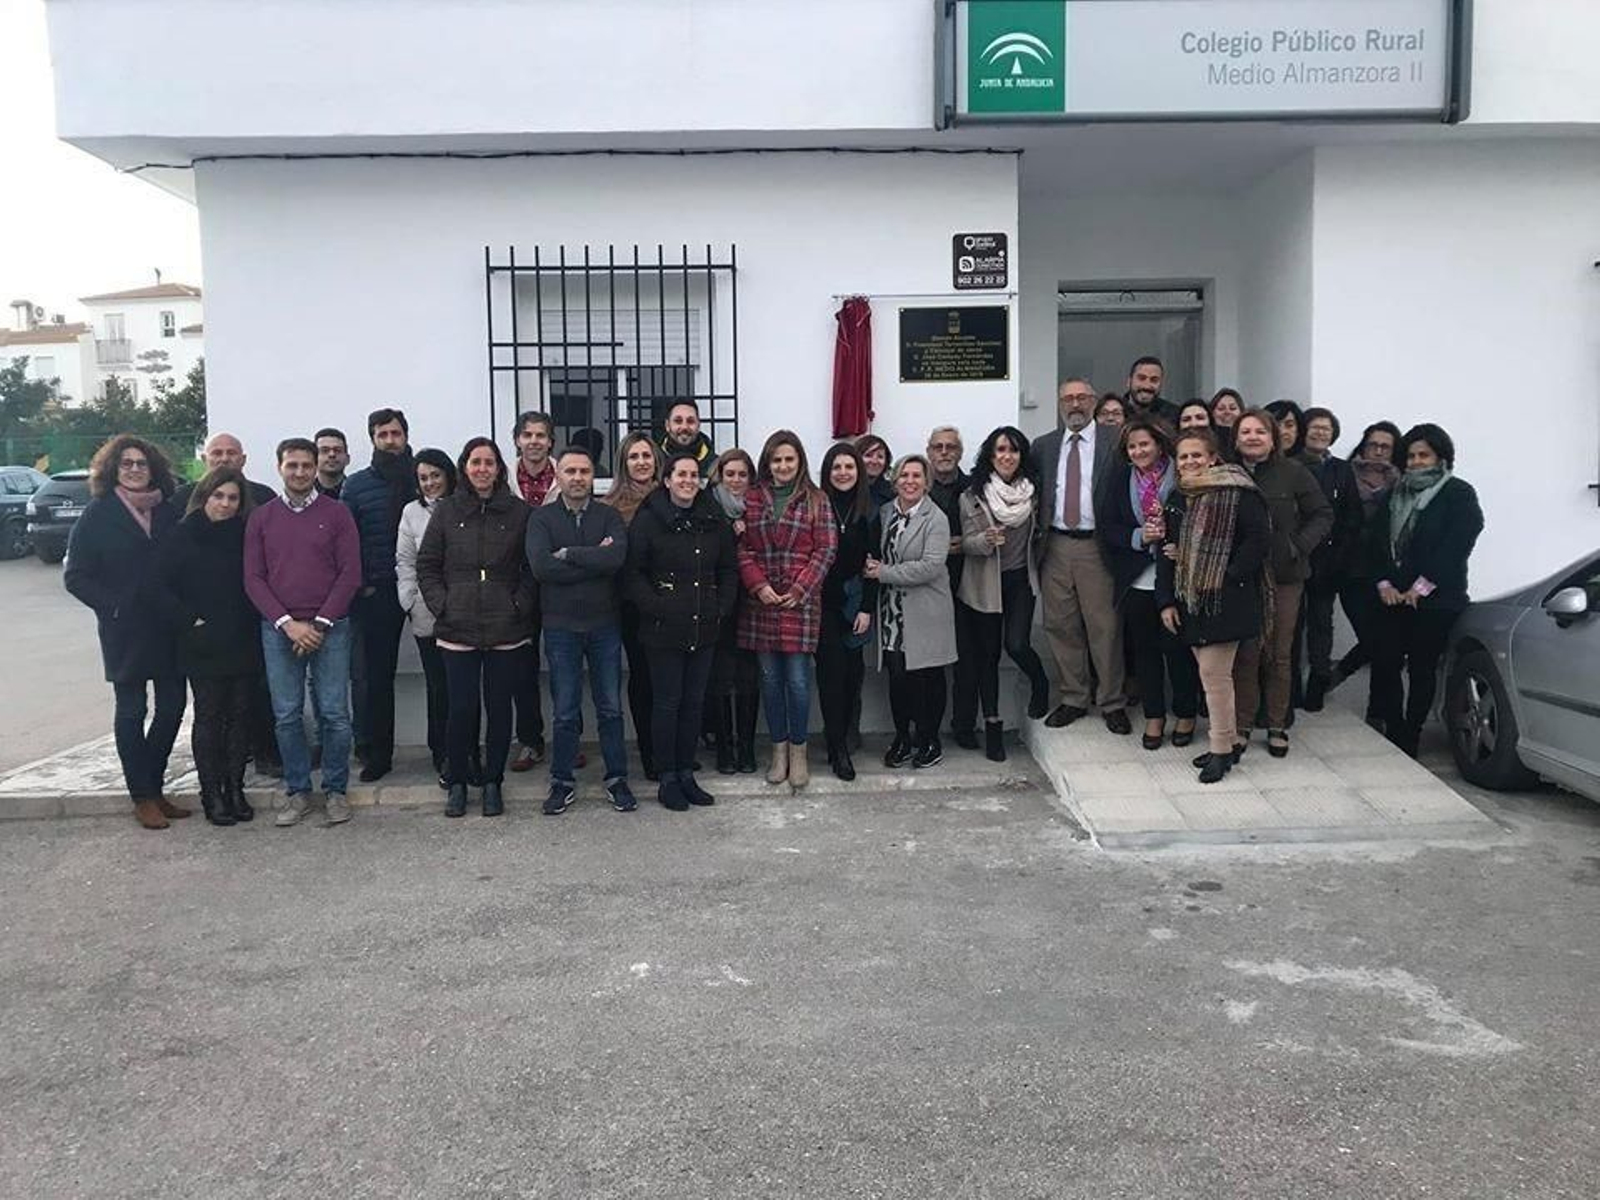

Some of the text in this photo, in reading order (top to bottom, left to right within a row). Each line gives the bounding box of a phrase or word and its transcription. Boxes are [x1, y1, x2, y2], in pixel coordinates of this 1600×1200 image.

[1181, 28, 1424, 58] Colegio Público Rural
[1207, 61, 1423, 85] Medio Almanzora II
